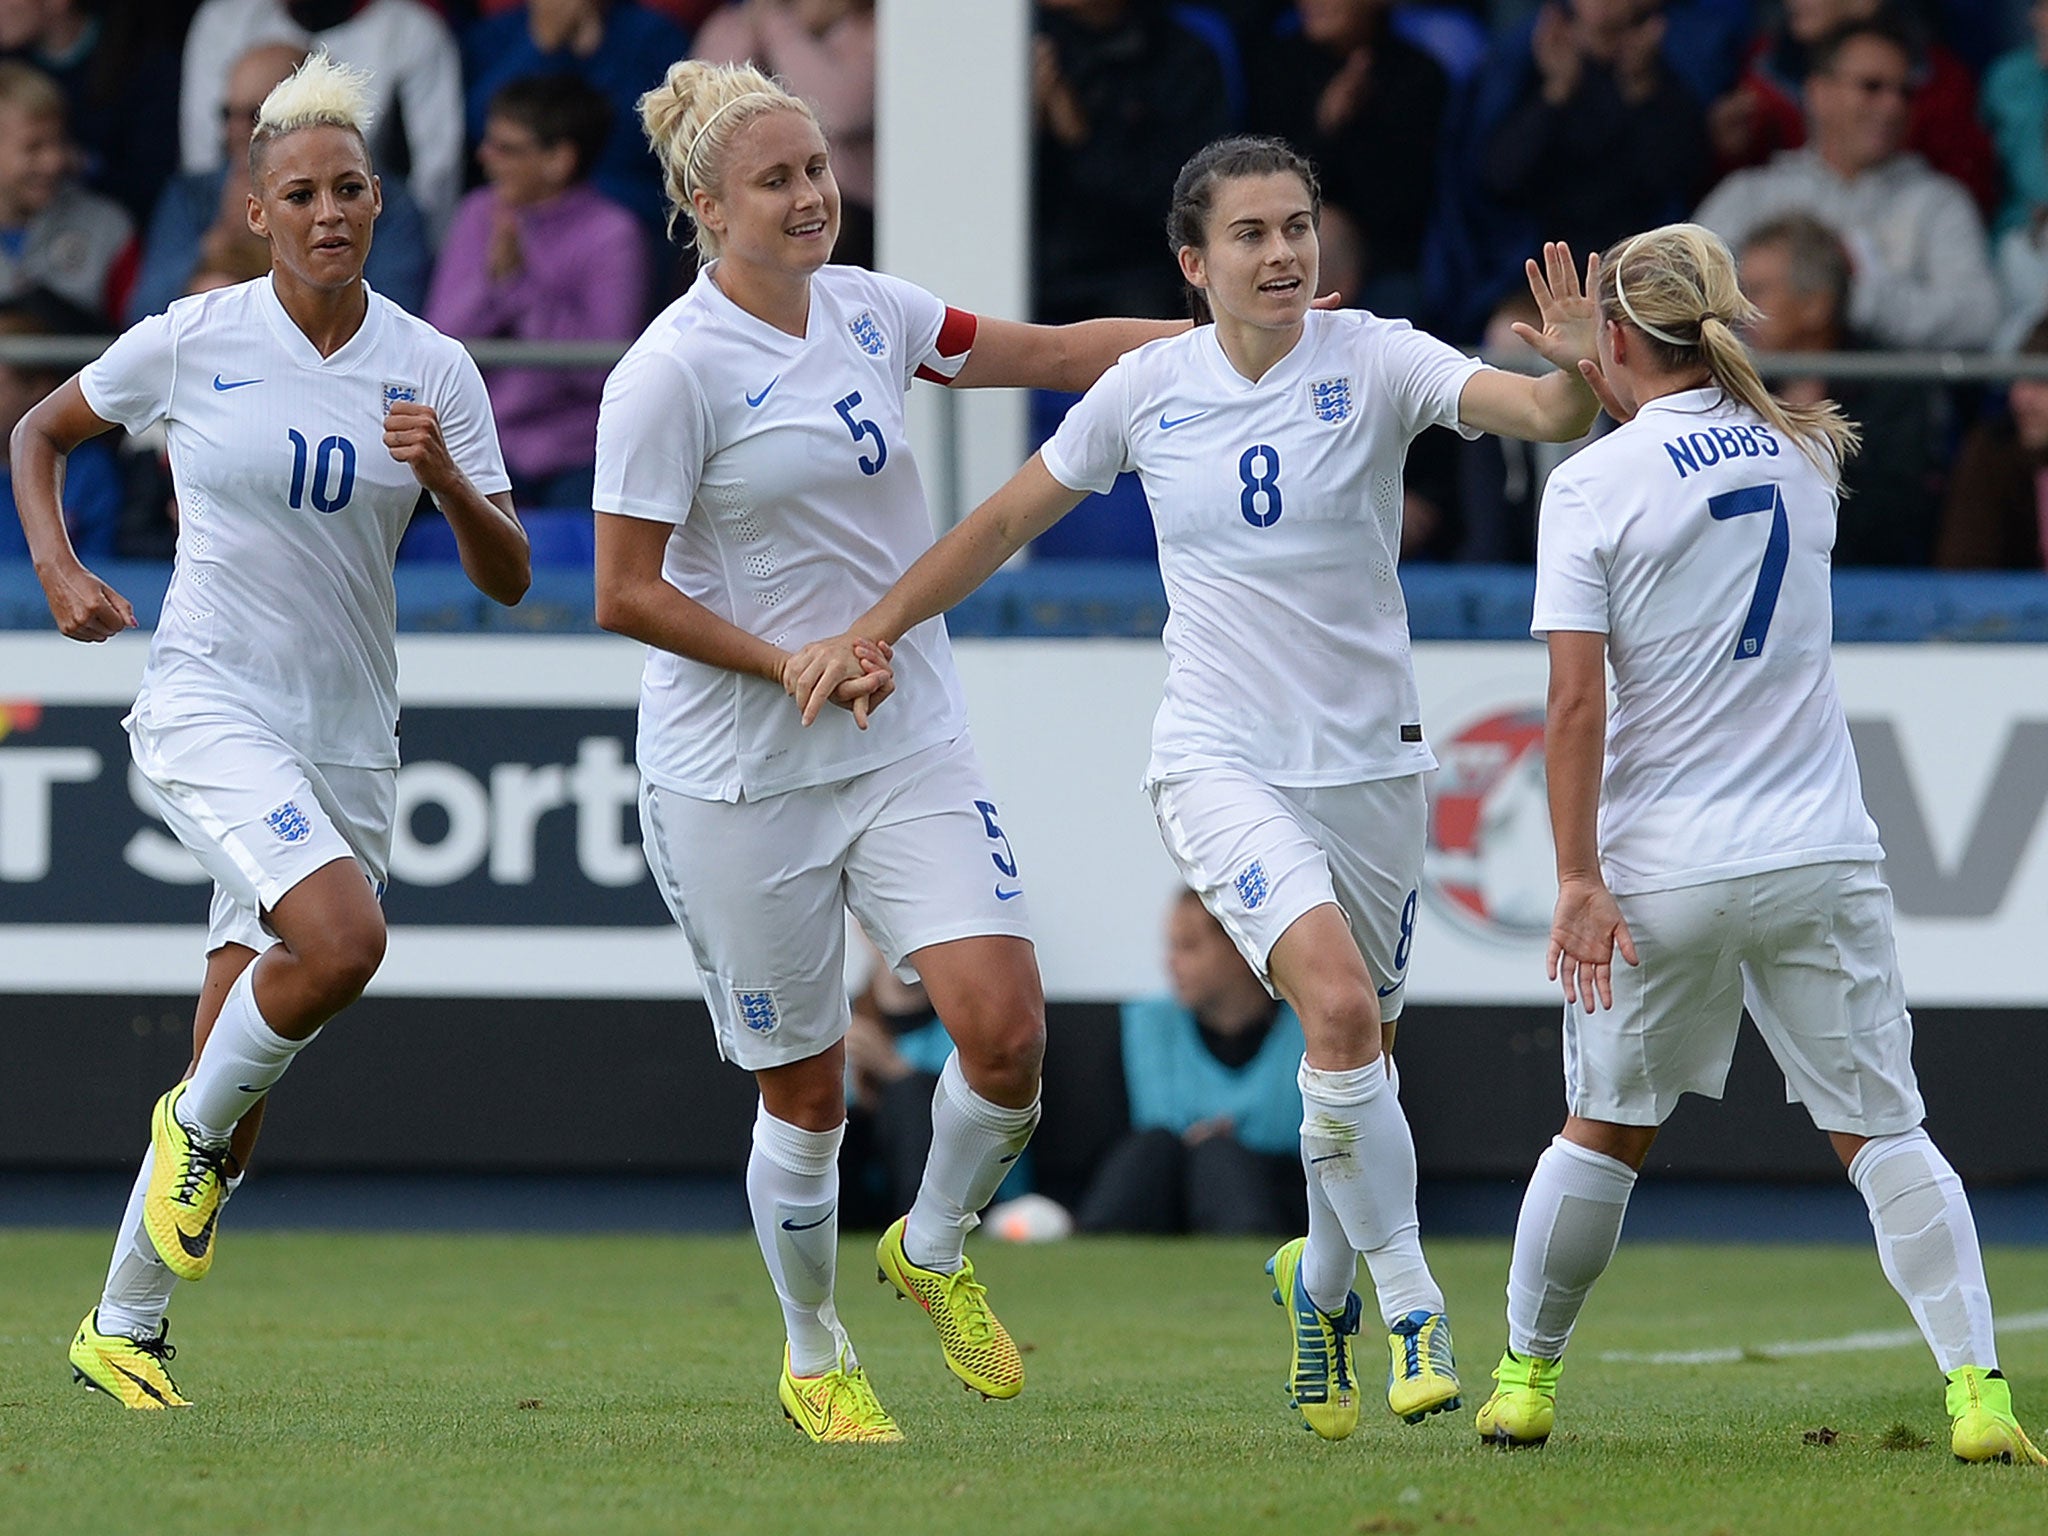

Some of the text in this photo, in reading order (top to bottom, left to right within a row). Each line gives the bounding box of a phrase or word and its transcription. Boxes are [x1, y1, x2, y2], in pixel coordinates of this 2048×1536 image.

[288, 427, 357, 514] 10
[832, 390, 888, 476] 5
[1663, 425, 1780, 479] NOBBS
[1238, 444, 1283, 528] 8
[1707, 483, 1790, 660] 7
[973, 799, 1018, 878] 5
[1394, 888, 1417, 971] 8
